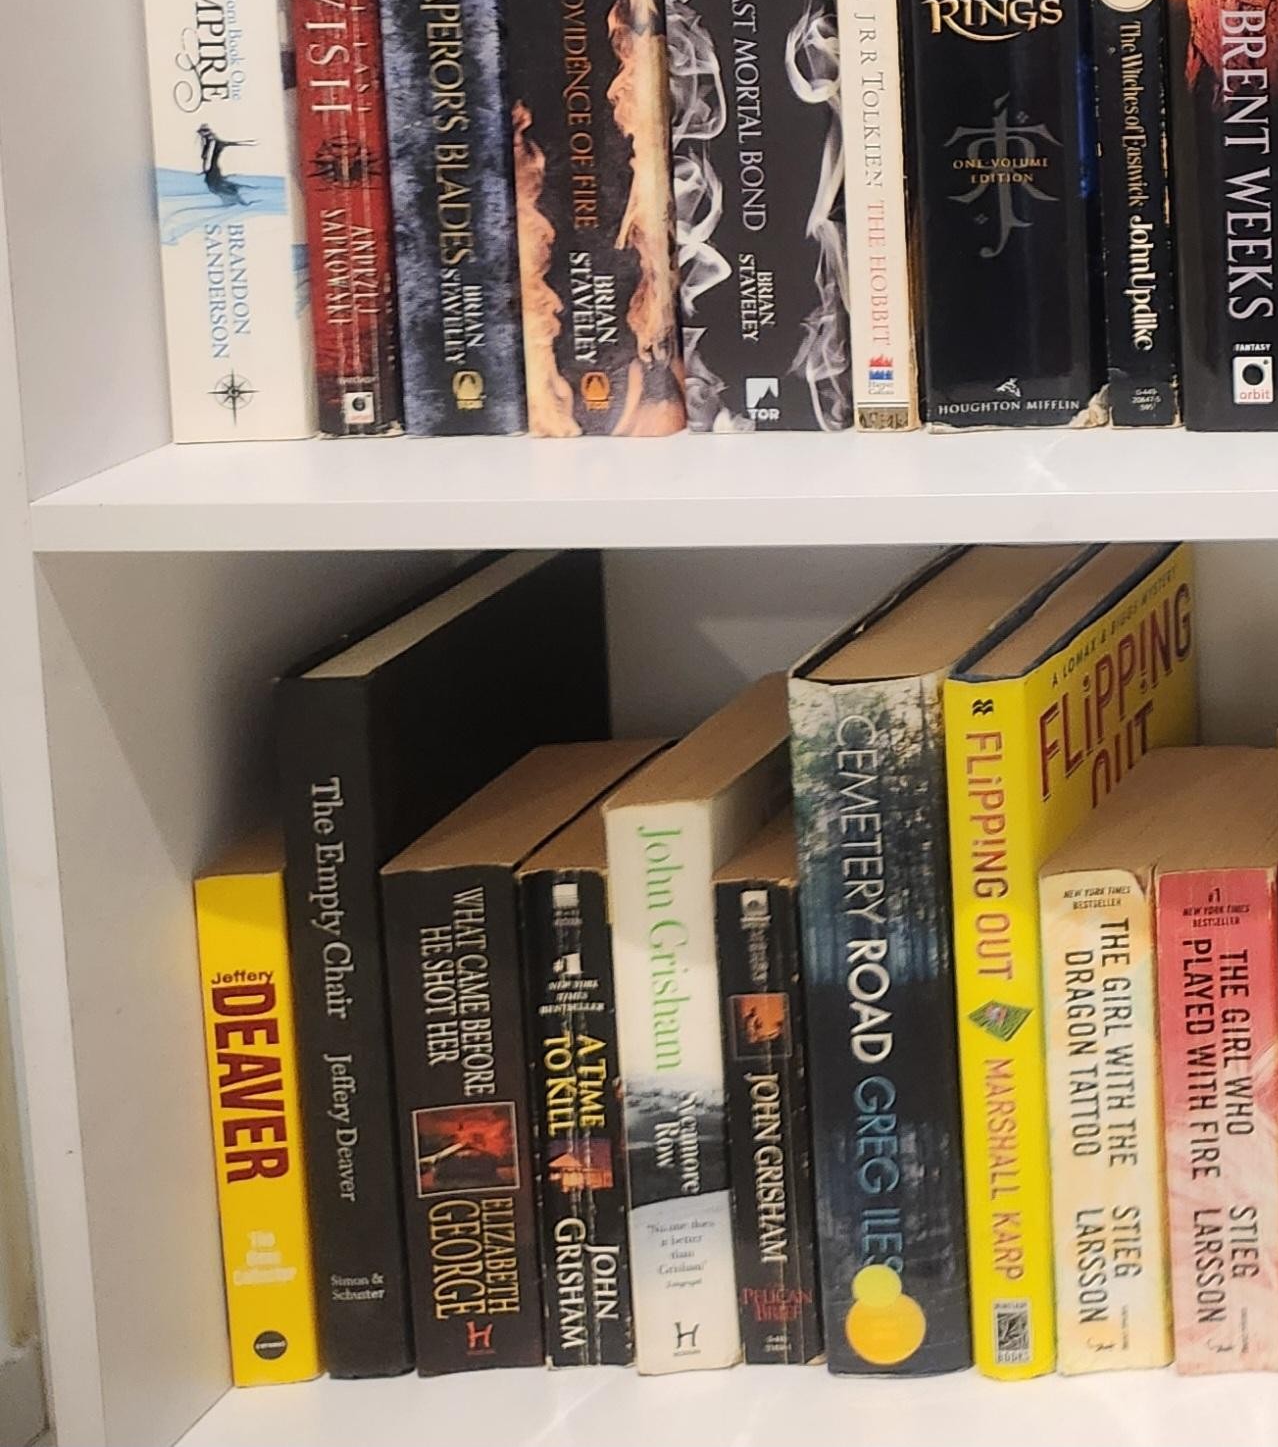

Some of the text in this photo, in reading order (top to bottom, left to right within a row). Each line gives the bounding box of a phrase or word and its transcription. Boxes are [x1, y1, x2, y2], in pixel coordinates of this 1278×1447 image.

[1220, 9, 1274, 322] BRENT WEEKS
[203, 224, 229, 360] SANDERSON
[226, 225, 253, 336] BRANDON
[938, 399, 1080, 414] HOUGHTON MIFFLIN
[211, 969, 274, 986] Jeffery
[310, 778, 354, 1019] The Empty Chair
[638, 824, 685, 1072] John Grisham
[836, 714, 900, 1195] CEMETERY ROAD GREG
[211, 984, 289, 1184] DEAVER
[1065, 950, 1100, 1158] DRAGON TATTOO
[1101, 919, 1137, 1166] THE GIRL WITH THE
[429, 1199, 486, 1321] GEORGE
[480, 1196, 520, 1315] ELIZABETH
[983, 1057, 1024, 1283] MARSHALL KARP
